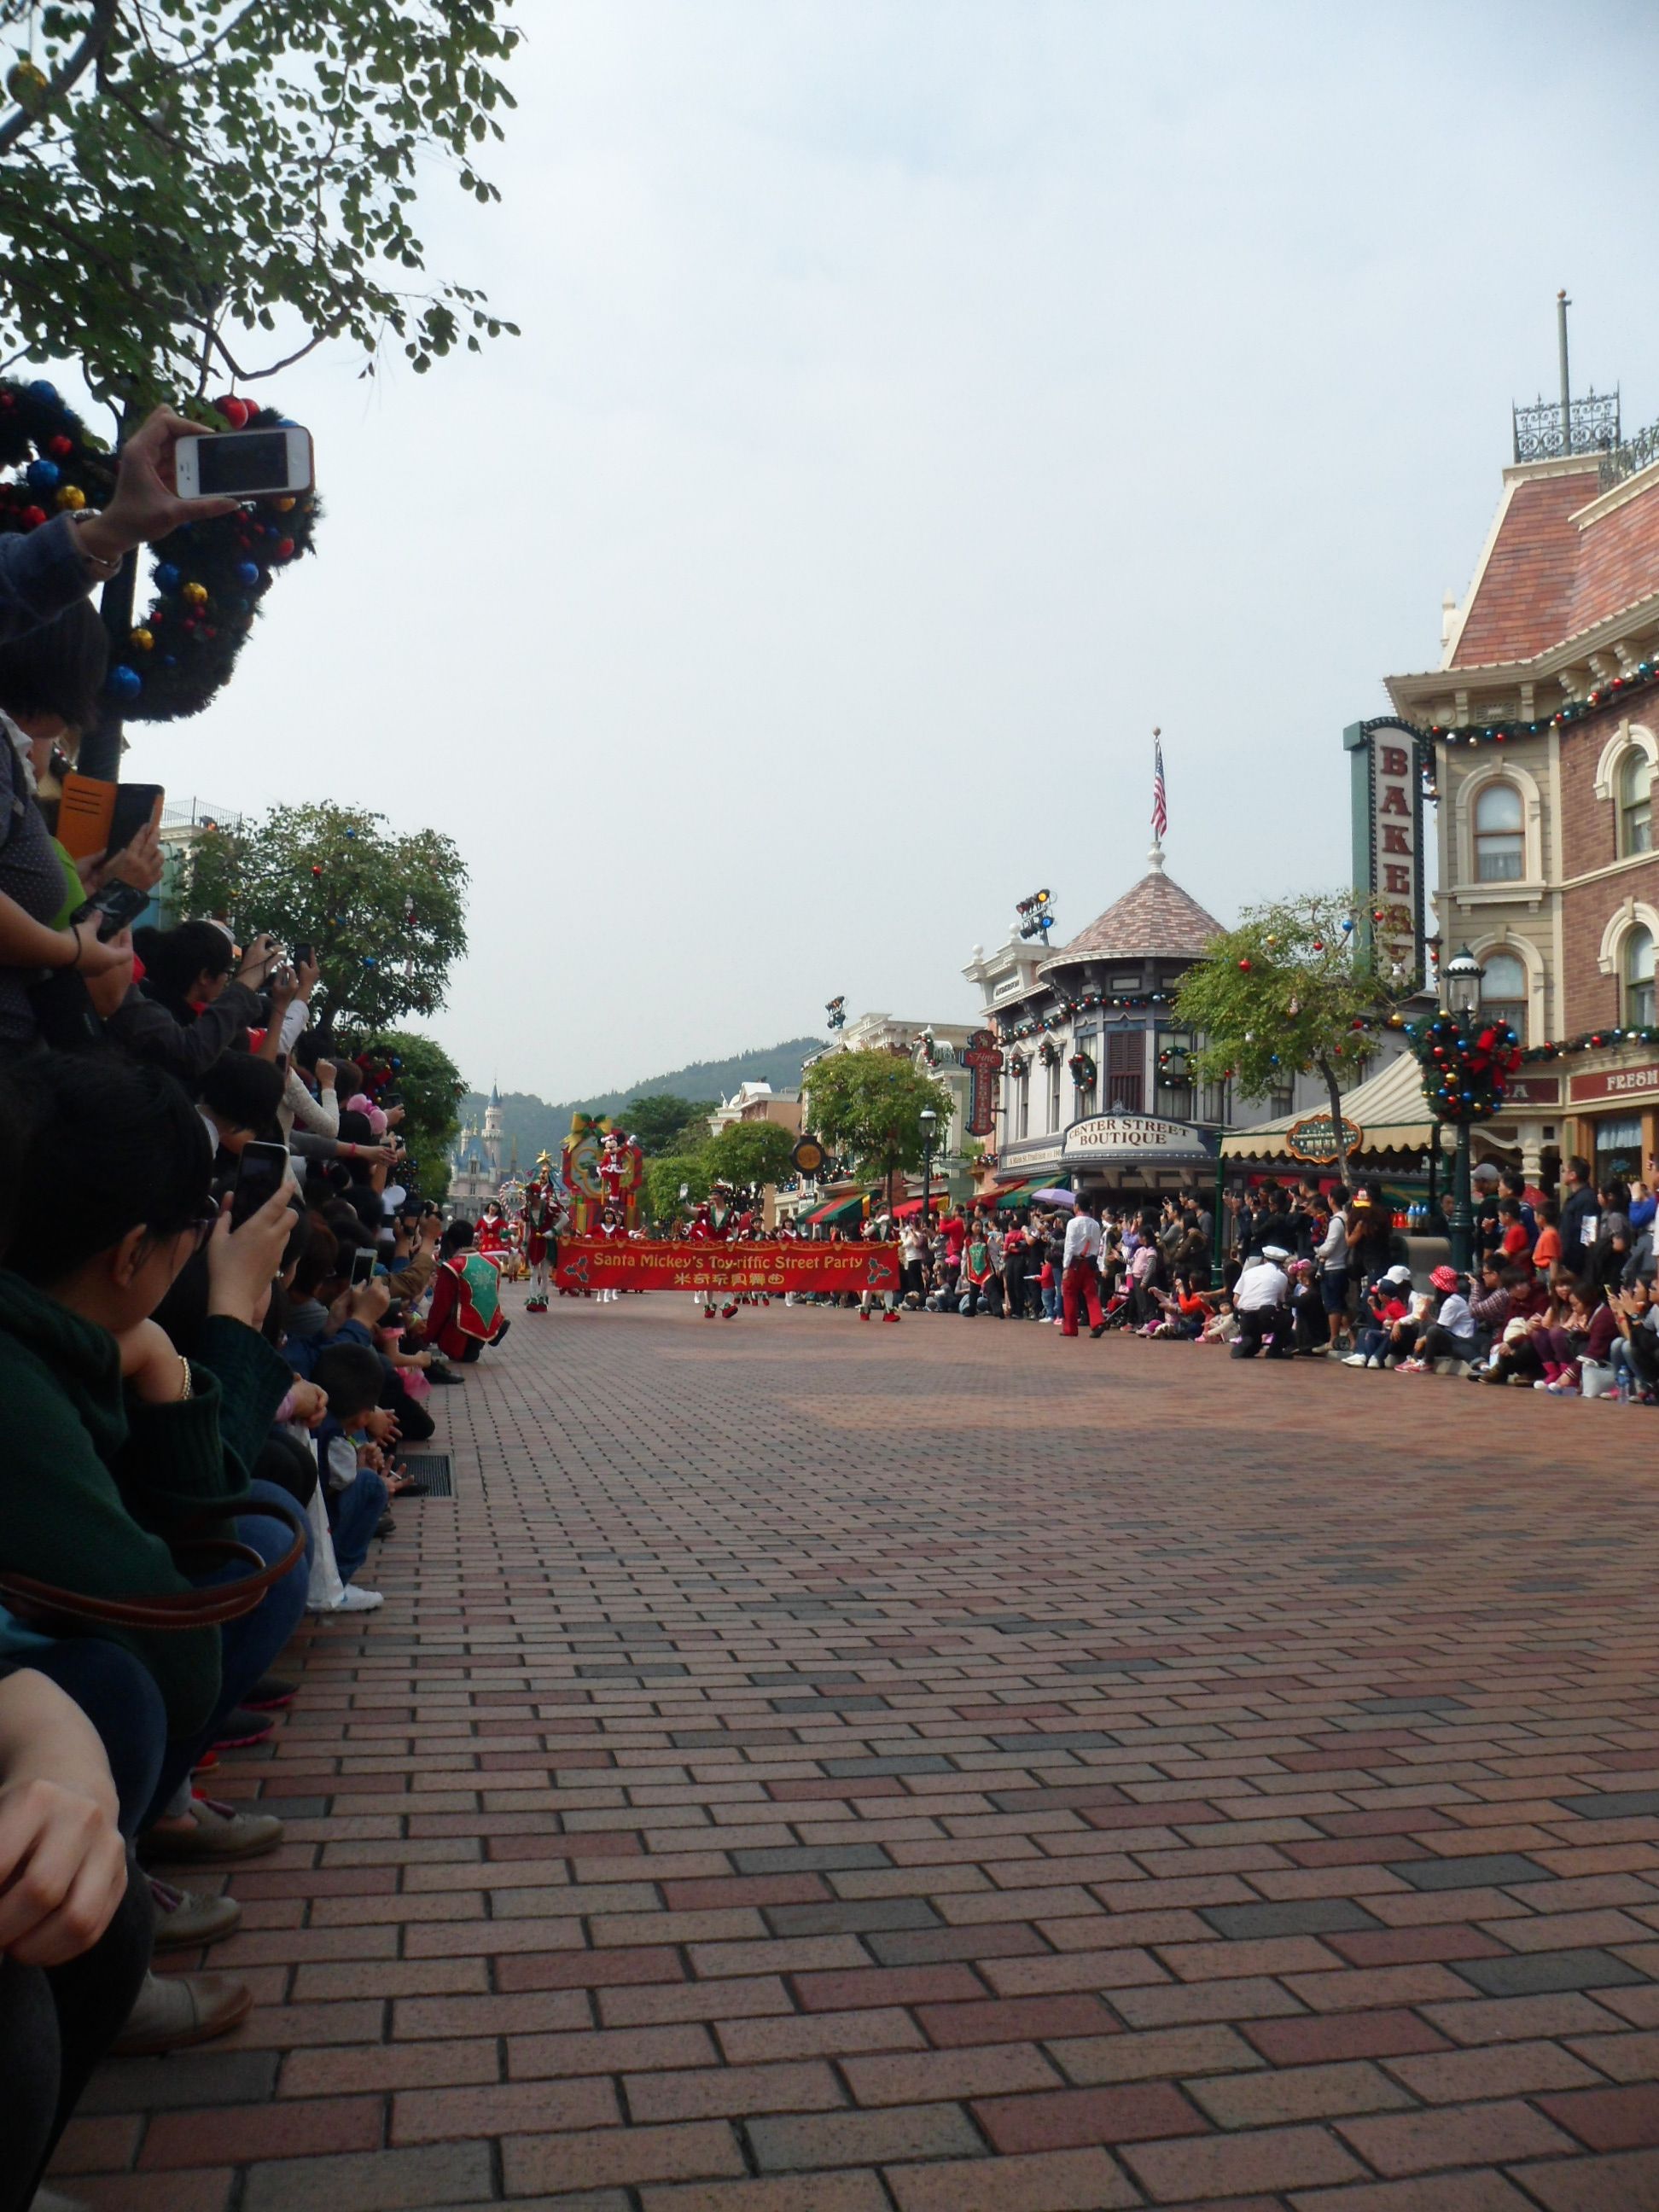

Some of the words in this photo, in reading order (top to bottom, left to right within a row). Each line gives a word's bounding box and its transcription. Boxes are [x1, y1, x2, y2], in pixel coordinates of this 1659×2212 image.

[1069, 1119, 1116, 1139] CENTER
[1122, 1120, 1189, 1137] STREET
[1080, 1132, 1167, 1146] BOUTIQUE
[594, 1253, 635, 1266] Santa
[640, 1254, 703, 1269] Mickey's
[709, 1255, 771, 1269] Toy-riffic
[775, 1256, 819, 1268] Street
[824, 1256, 863, 1268] Party
